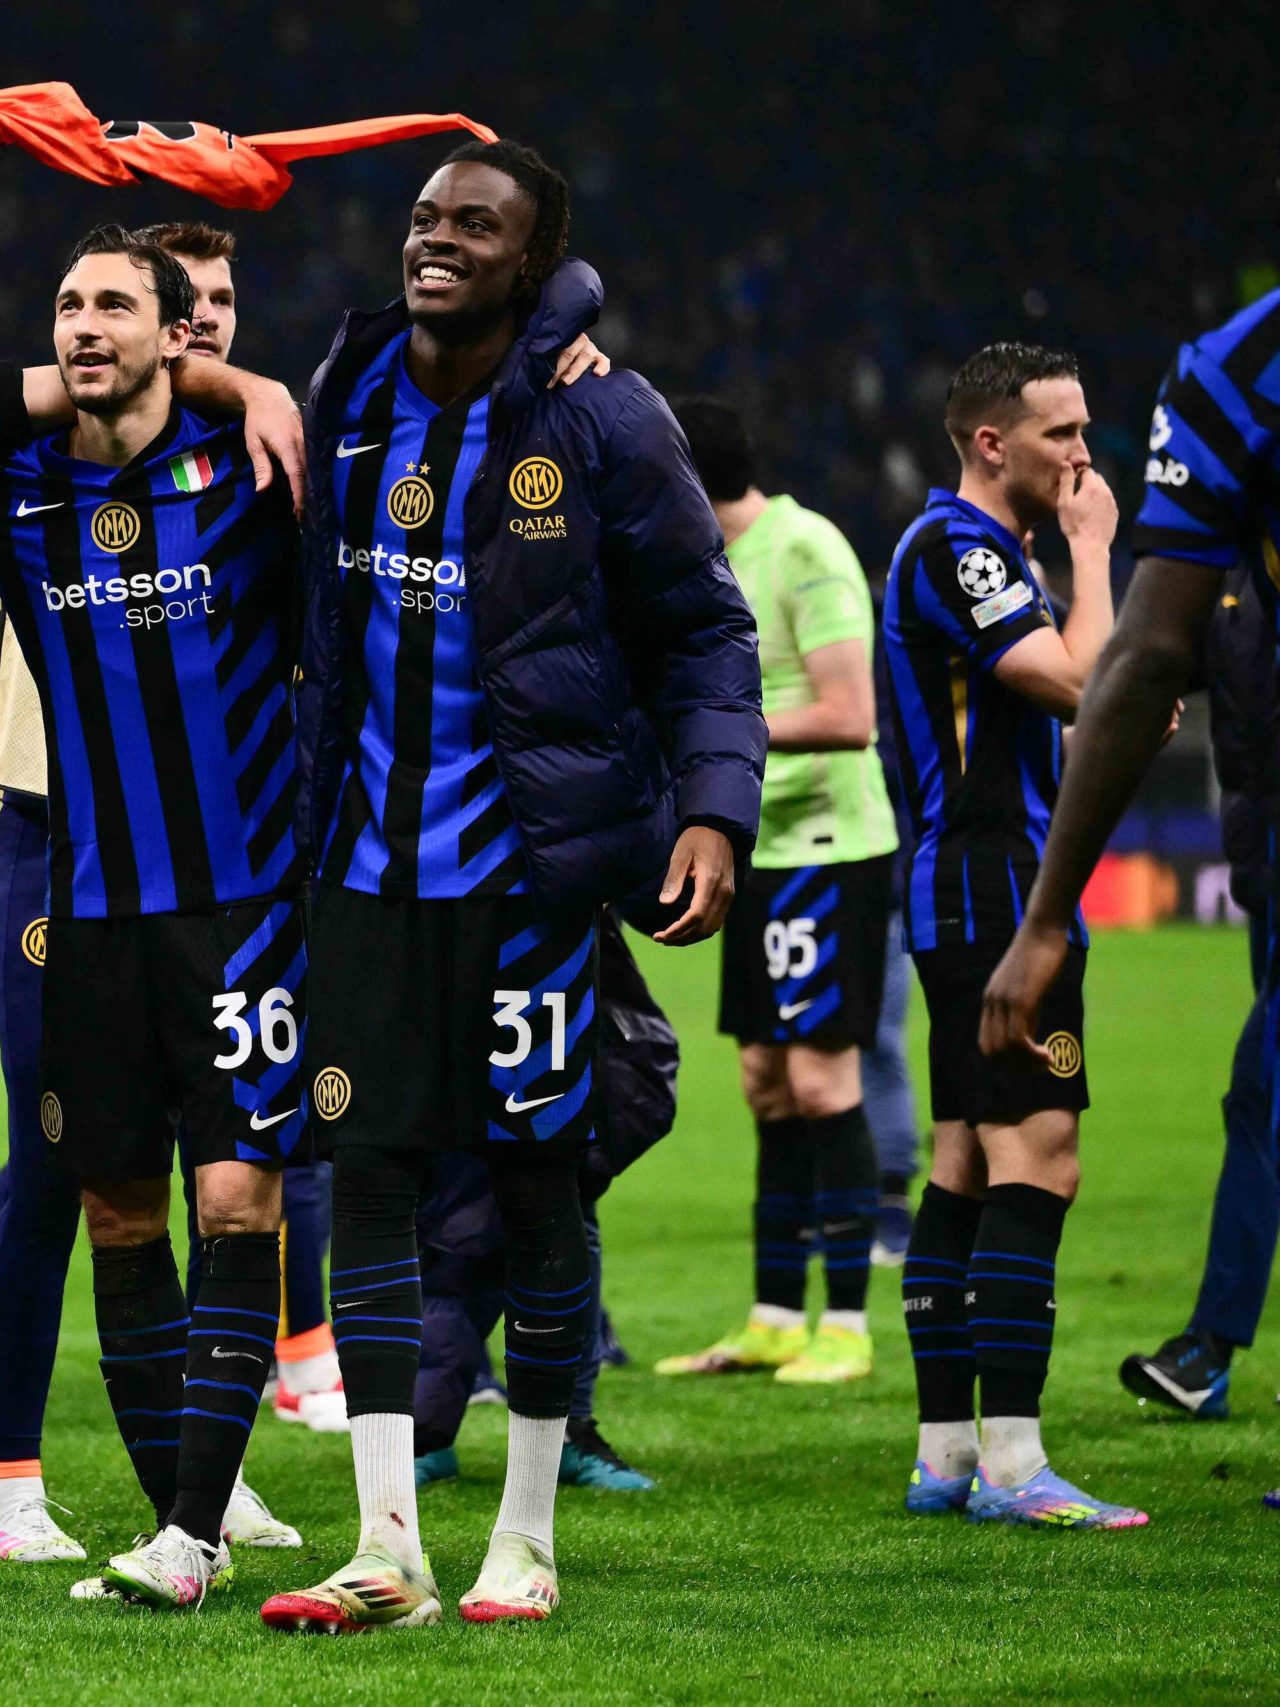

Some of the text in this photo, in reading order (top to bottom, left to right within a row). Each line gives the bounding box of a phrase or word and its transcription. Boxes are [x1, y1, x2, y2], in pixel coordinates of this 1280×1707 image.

[509, 515, 567, 534] QATAR
[523, 528, 567, 541] AIRWAYS
[42, 563, 212, 612] betsson
[392, 589, 466, 614] .spor
[119, 591, 216, 630] .sport
[763, 917, 818, 980] 95
[211, 986, 298, 1070] 36
[488, 989, 566, 1071] 31
